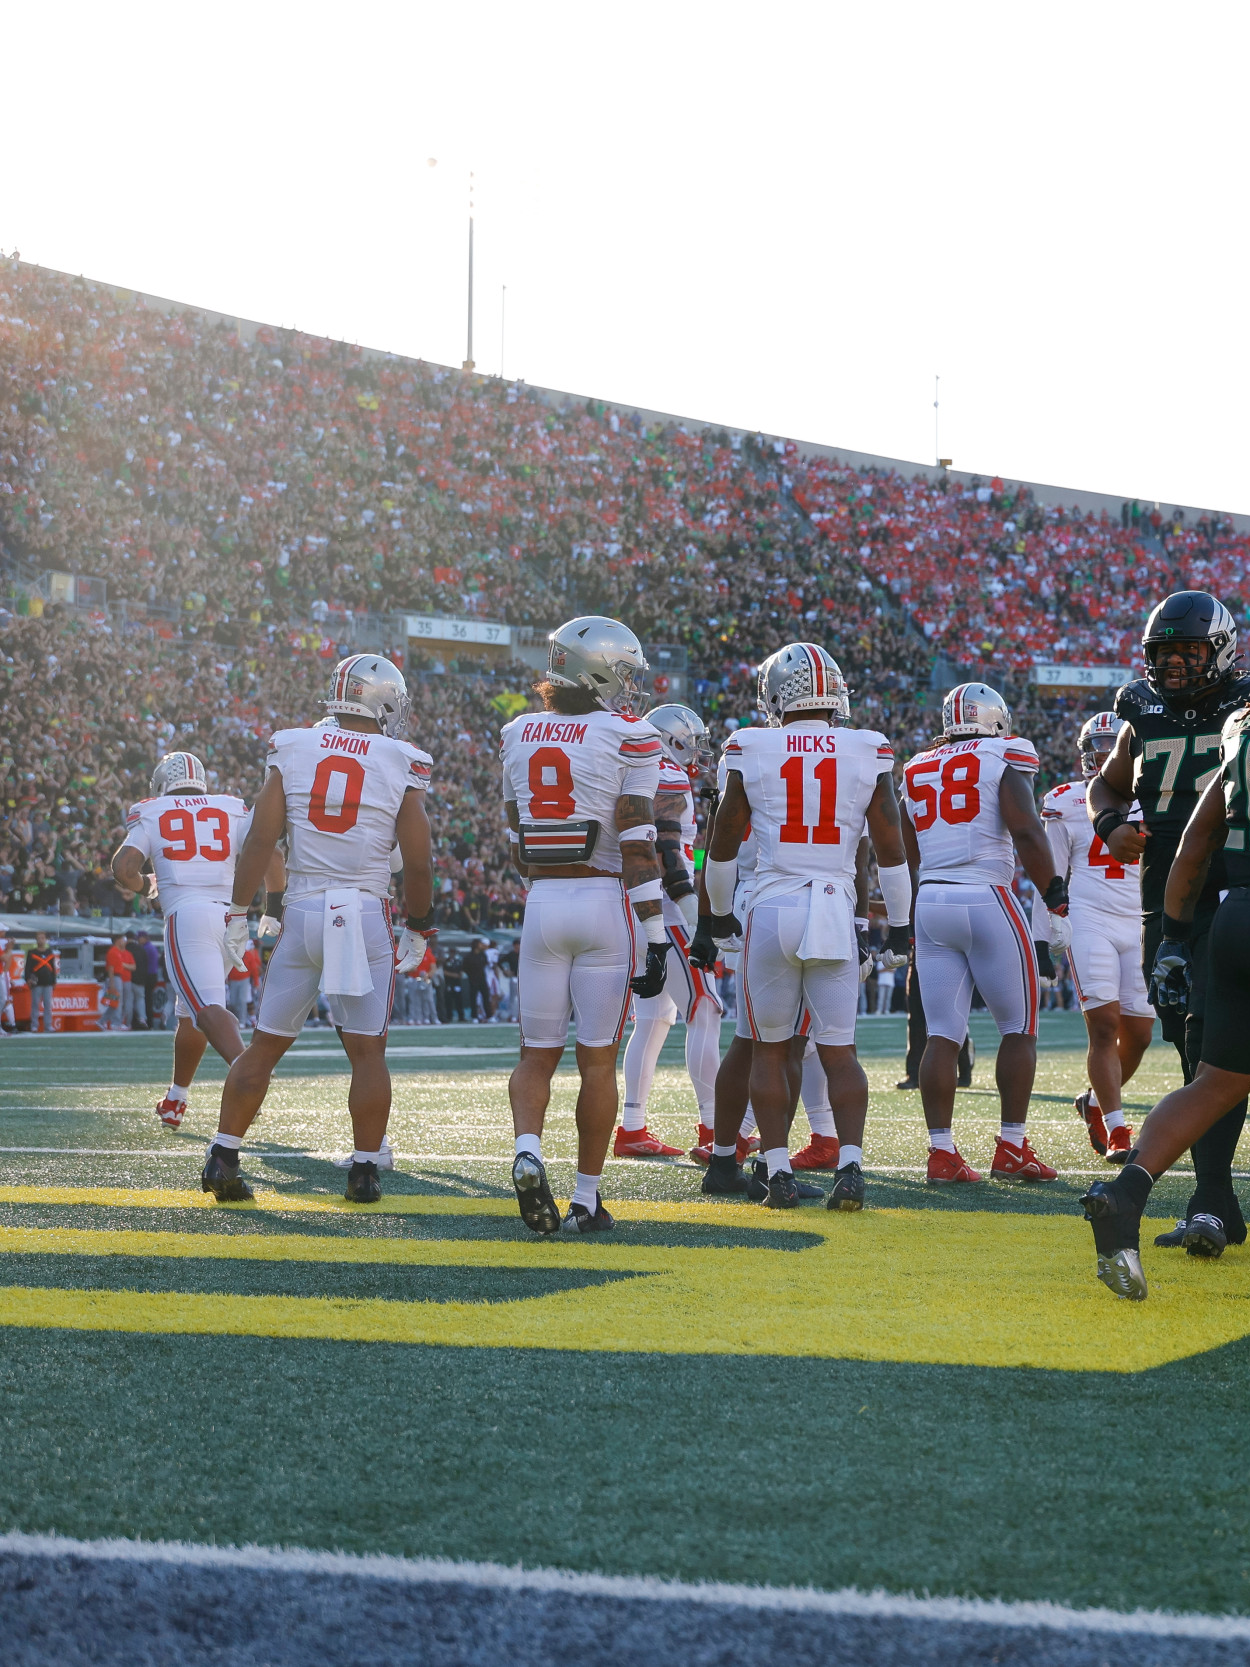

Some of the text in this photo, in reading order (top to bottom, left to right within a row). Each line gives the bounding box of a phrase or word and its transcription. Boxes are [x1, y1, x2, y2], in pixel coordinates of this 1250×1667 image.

[417, 620, 501, 641] 35 36 37
[1046, 669, 1125, 684] 37 38 39
[796, 700, 839, 708] BUCKEYES
[320, 732, 371, 756] SIMON
[520, 721, 588, 744] RANSOM
[786, 734, 836, 753] HICKS
[919, 740, 982, 762] HAMILTON
[307, 754, 366, 834] 0
[528, 746, 577, 820] 8
[905, 752, 981, 833] 58
[174, 797, 209, 809] KANU
[779, 756, 841, 845] 11
[158, 806, 231, 862] 93
